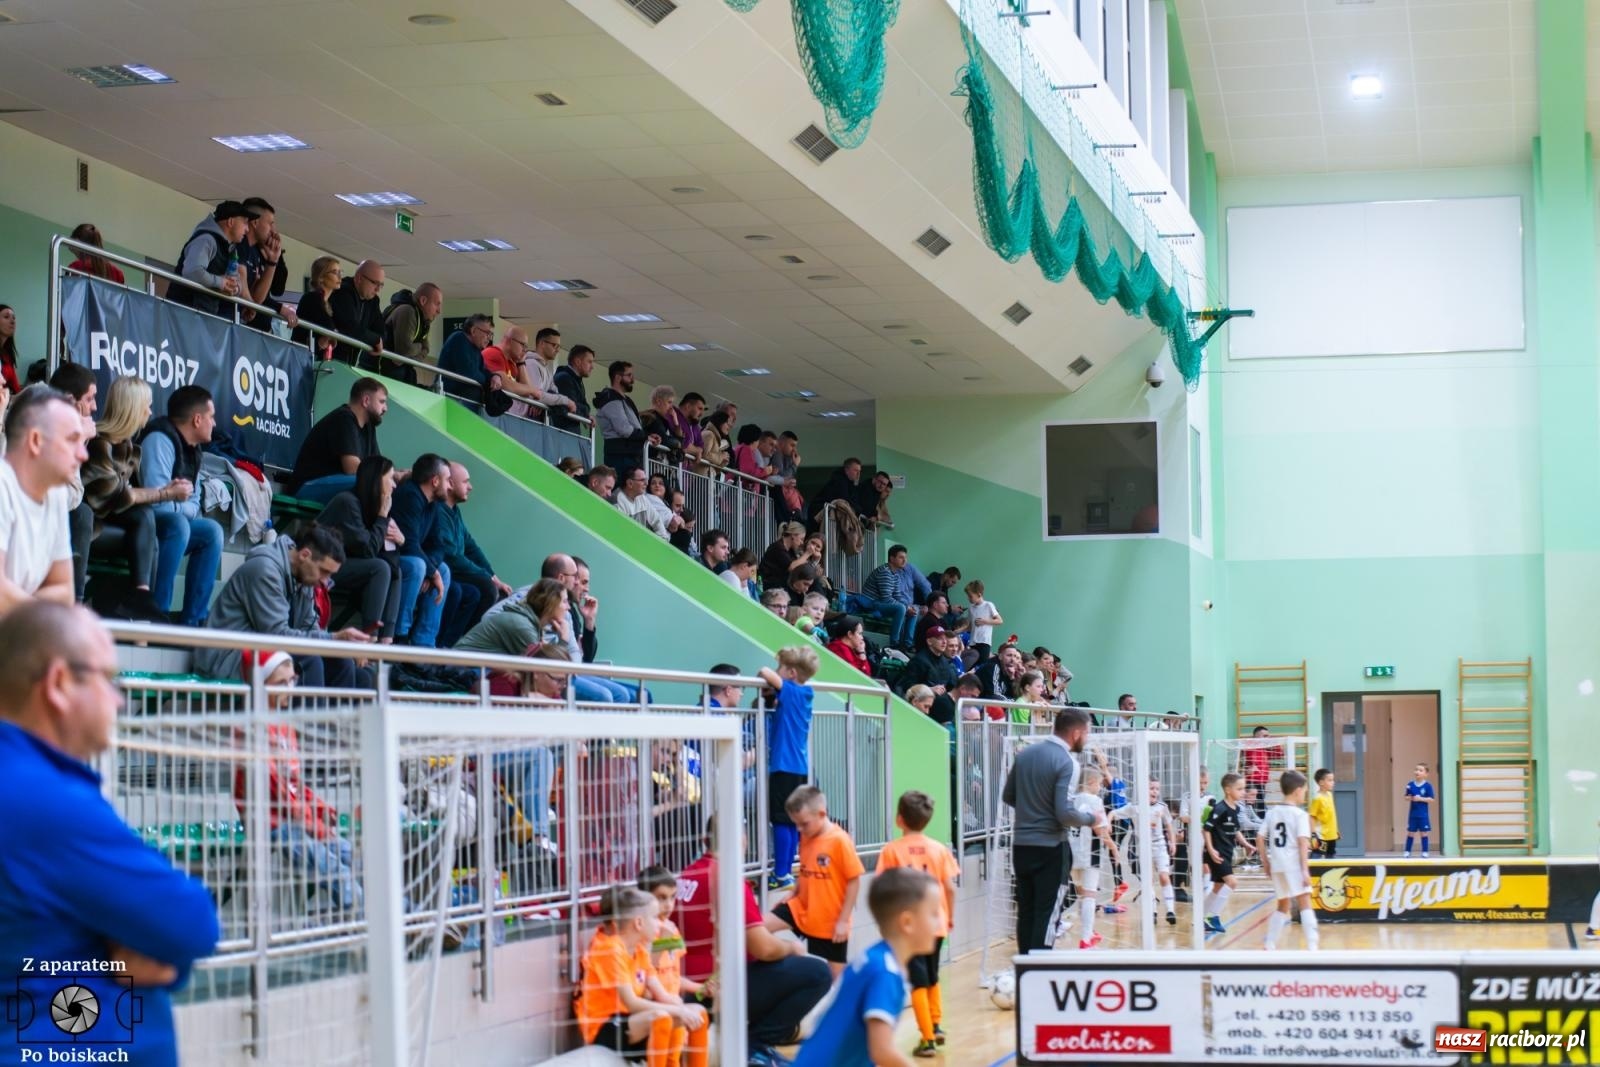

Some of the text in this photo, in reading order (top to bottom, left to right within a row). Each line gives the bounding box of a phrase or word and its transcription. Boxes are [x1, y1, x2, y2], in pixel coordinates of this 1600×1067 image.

[91, 331, 200, 390] RACIBÓRZ
[256, 415, 291, 439] RACIBÓRZ
[1274, 822, 1287, 848] 3
[1368, 864, 1500, 920] 4teams
[1453, 910, 1546, 920] www.4teams.cz
[1213, 981, 1427, 1003] www.delameweby.cz
[1470, 977, 1530, 1000] ZDE
[1235, 1010, 1413, 1022] tel. +420 596 113 850
[1047, 1028, 1155, 1050] evolution
[1227, 1028, 1266, 1039] mob.
[1274, 1028, 1312, 1039] +420
[1318, 1028, 1348, 1039] 604
[1354, 1029, 1383, 1040] 941
